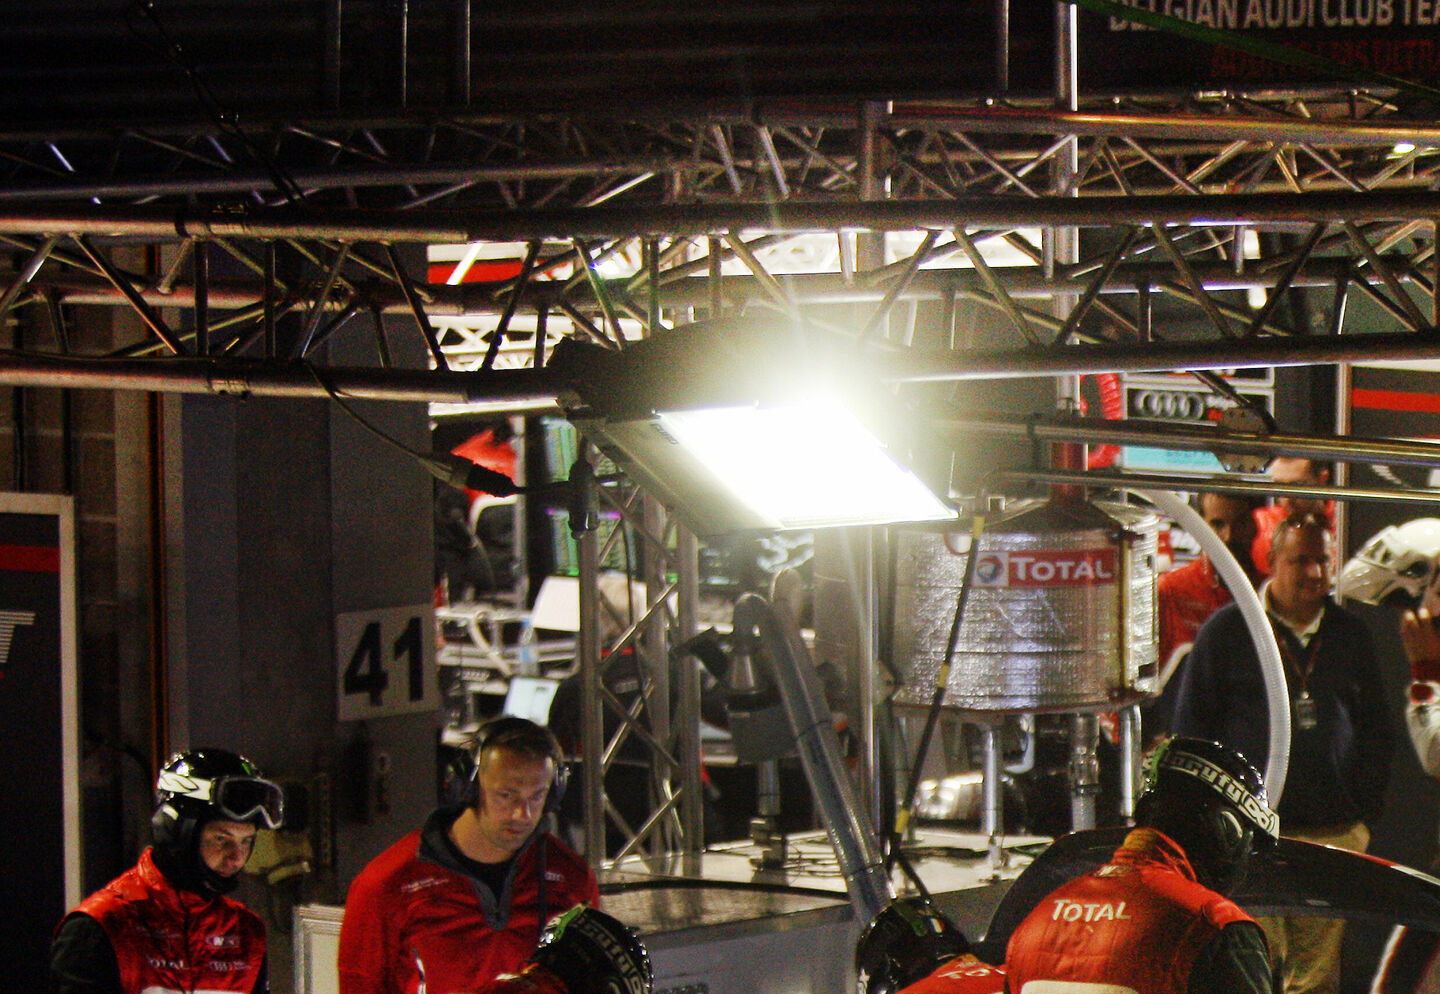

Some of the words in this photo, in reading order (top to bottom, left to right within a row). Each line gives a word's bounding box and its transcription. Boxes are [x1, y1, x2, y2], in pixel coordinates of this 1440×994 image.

[1243, 0, 1316, 28] AUDI
[1321, 0, 1394, 26] CLUB
[1009, 556, 1113, 581] TOTAL
[344, 617, 424, 706] 41
[1052, 899, 1131, 922] TOTAL
